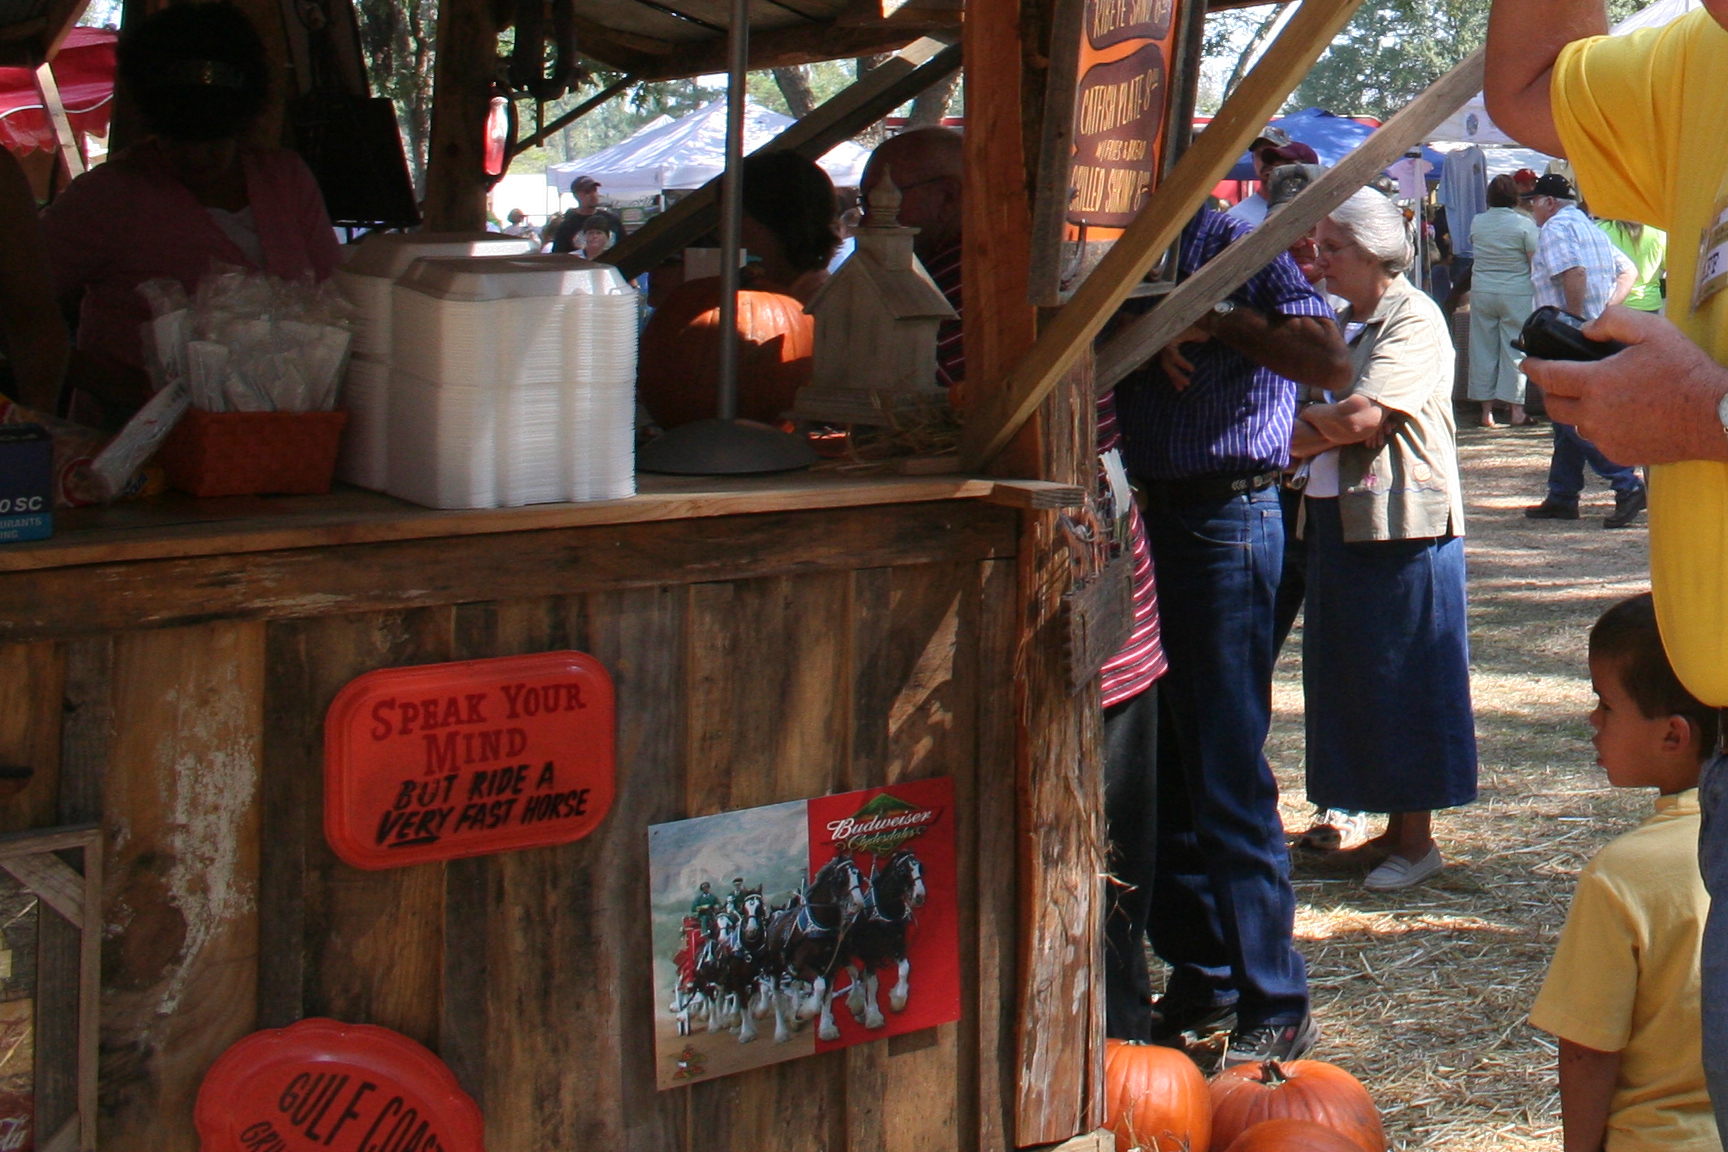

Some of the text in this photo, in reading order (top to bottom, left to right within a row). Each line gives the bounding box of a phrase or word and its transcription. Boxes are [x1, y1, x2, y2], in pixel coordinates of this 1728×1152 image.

[1080, 84, 1117, 136] CATFISH
[1116, 74, 1145, 127] PLATE
[14, 496, 43, 511] SC
[371, 683, 586, 741] SPEAK YOUR
[423, 728, 528, 777] MIND
[394, 761, 555, 811] BUT RIDE A
[374, 788, 591, 845] VERY FAST HORSE
[827, 810, 932, 841] Budweiser
[278, 1072, 378, 1146] GULF
